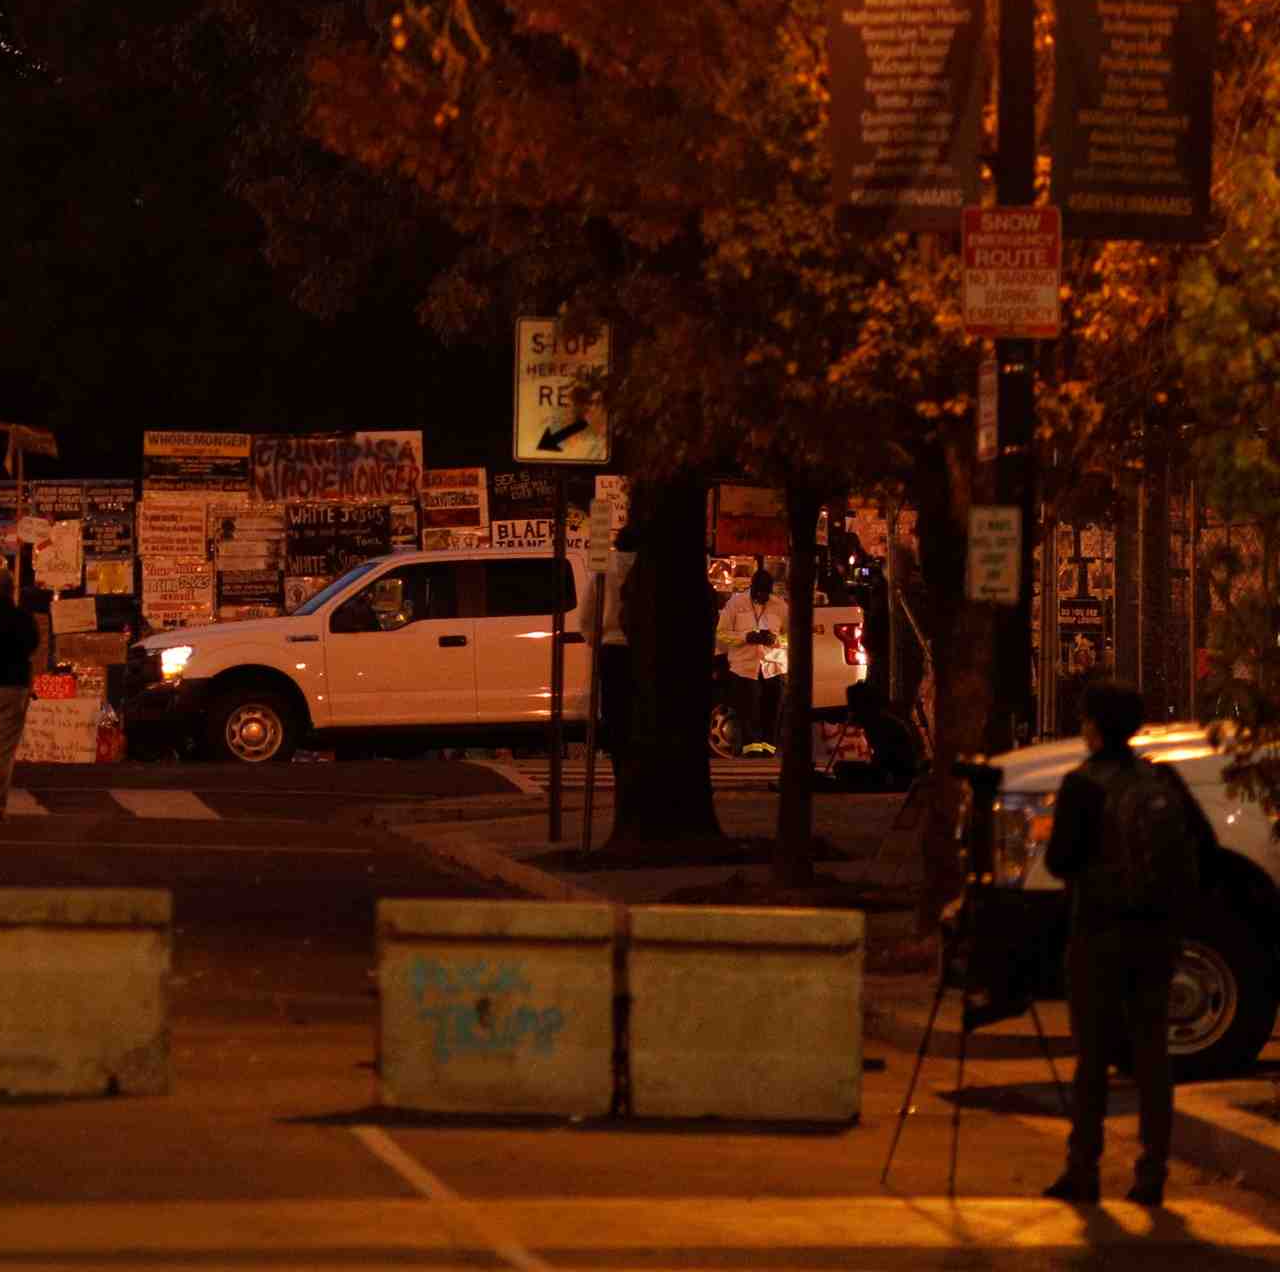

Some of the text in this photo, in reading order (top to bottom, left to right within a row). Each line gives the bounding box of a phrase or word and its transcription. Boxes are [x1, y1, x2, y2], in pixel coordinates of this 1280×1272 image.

[981, 213, 1040, 232] SNOW
[975, 249, 1048, 266] ROUTE
[539, 385, 583, 407] RE
[289, 508, 335, 524] WHITE
